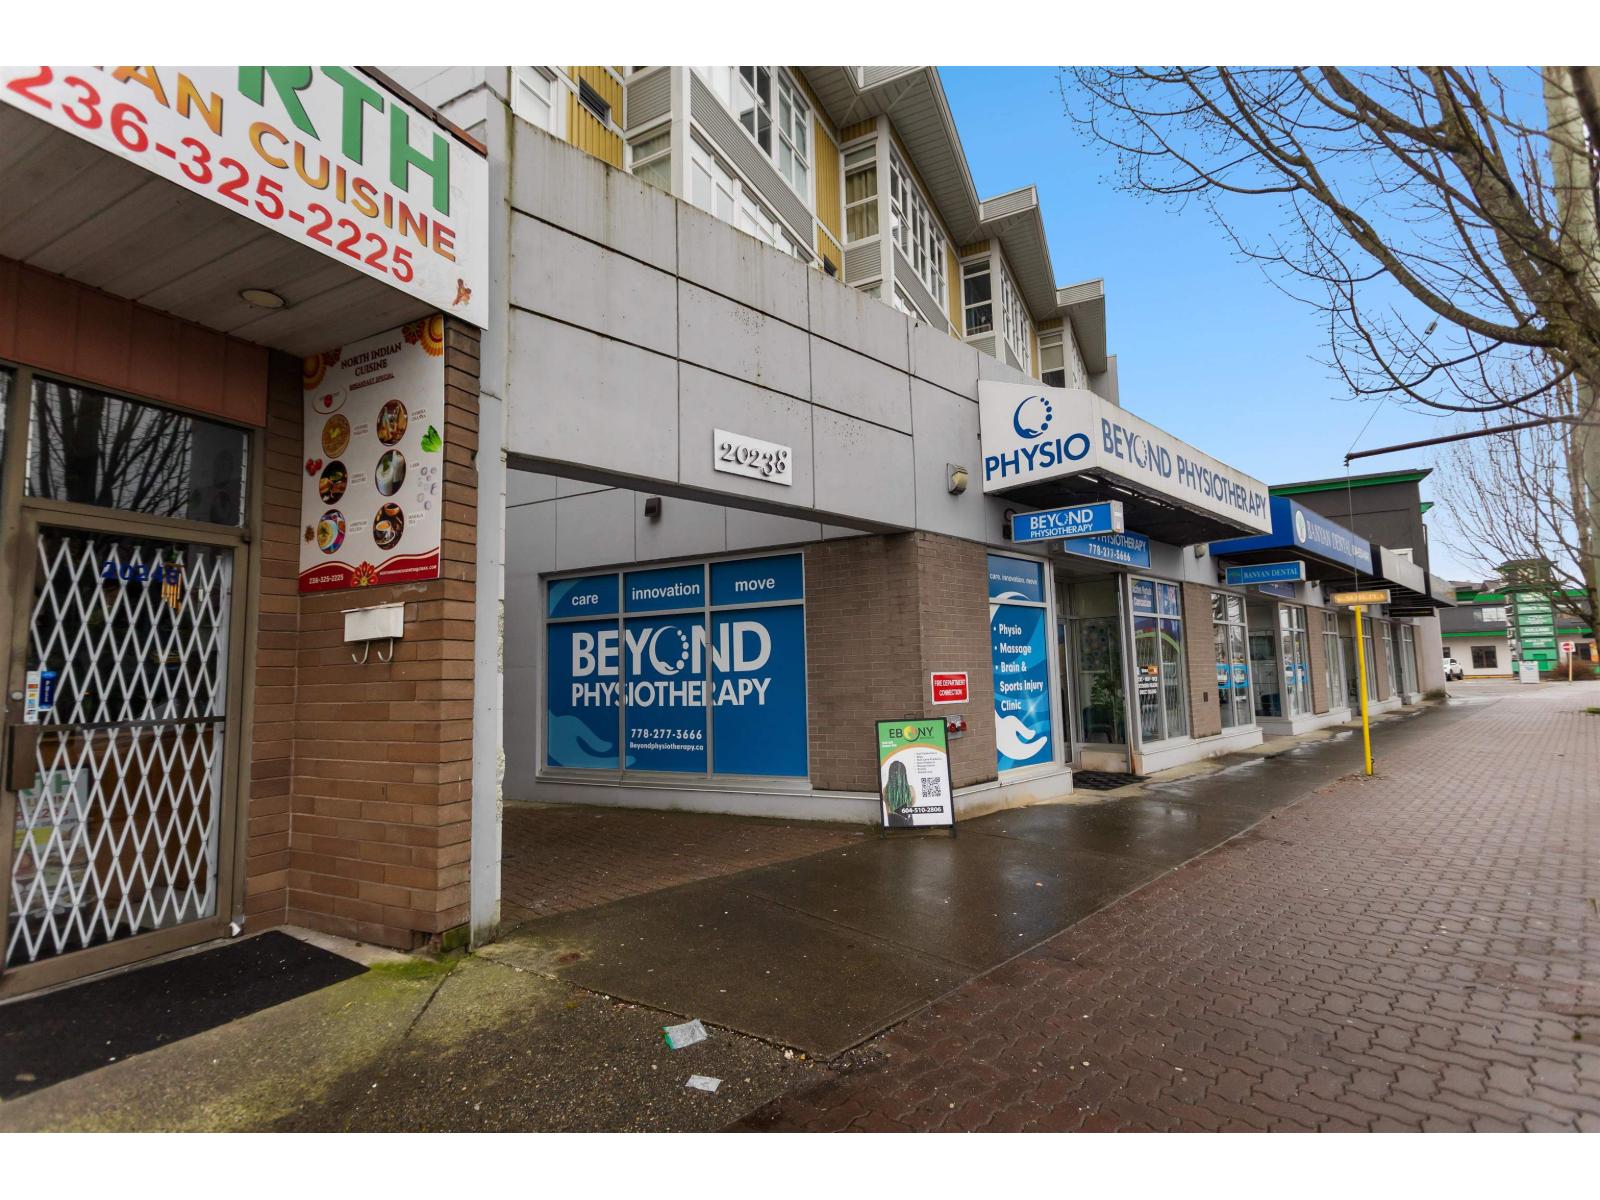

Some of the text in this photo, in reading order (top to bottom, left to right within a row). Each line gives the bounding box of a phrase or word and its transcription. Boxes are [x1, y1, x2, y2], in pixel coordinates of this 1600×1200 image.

[6, 66, 414, 284] 236-325-2225
[249, 121, 457, 263] CUISINE
[341, 342, 402, 370] NORTH INDIAN
[354, 359, 388, 376] CUISINE
[720, 442, 788, 477] 20238
[985, 432, 1090, 482] PHYSIO
[1101, 417, 1267, 520] BEYOND PHYSIOTHERAPY
[1030, 509, 1093, 530] BEYOND
[1030, 523, 1093, 538] PHYSIOTHERAPY
[1244, 568, 1297, 580] BANYAN DENTAL
[631, 583, 700, 601] innovation
[735, 577, 776, 592] move
[571, 593, 599, 606] care
[998, 624, 1022, 637] Physio
[572, 621, 772, 678] BEYOND
[1000, 642, 1032, 655] Massage
[1000, 661, 1027, 673] Brain &
[572, 677, 772, 708] PHYSIOTHERAPY
[1000, 680, 1043, 692] Sports Injury
[1001, 700, 1021, 711] Clinic
[631, 728, 703, 740] 778-277-3666
[629, 741, 704, 752] Beyondphysiotherapy.ca
[901, 806, 942, 815] 604-510-2806
